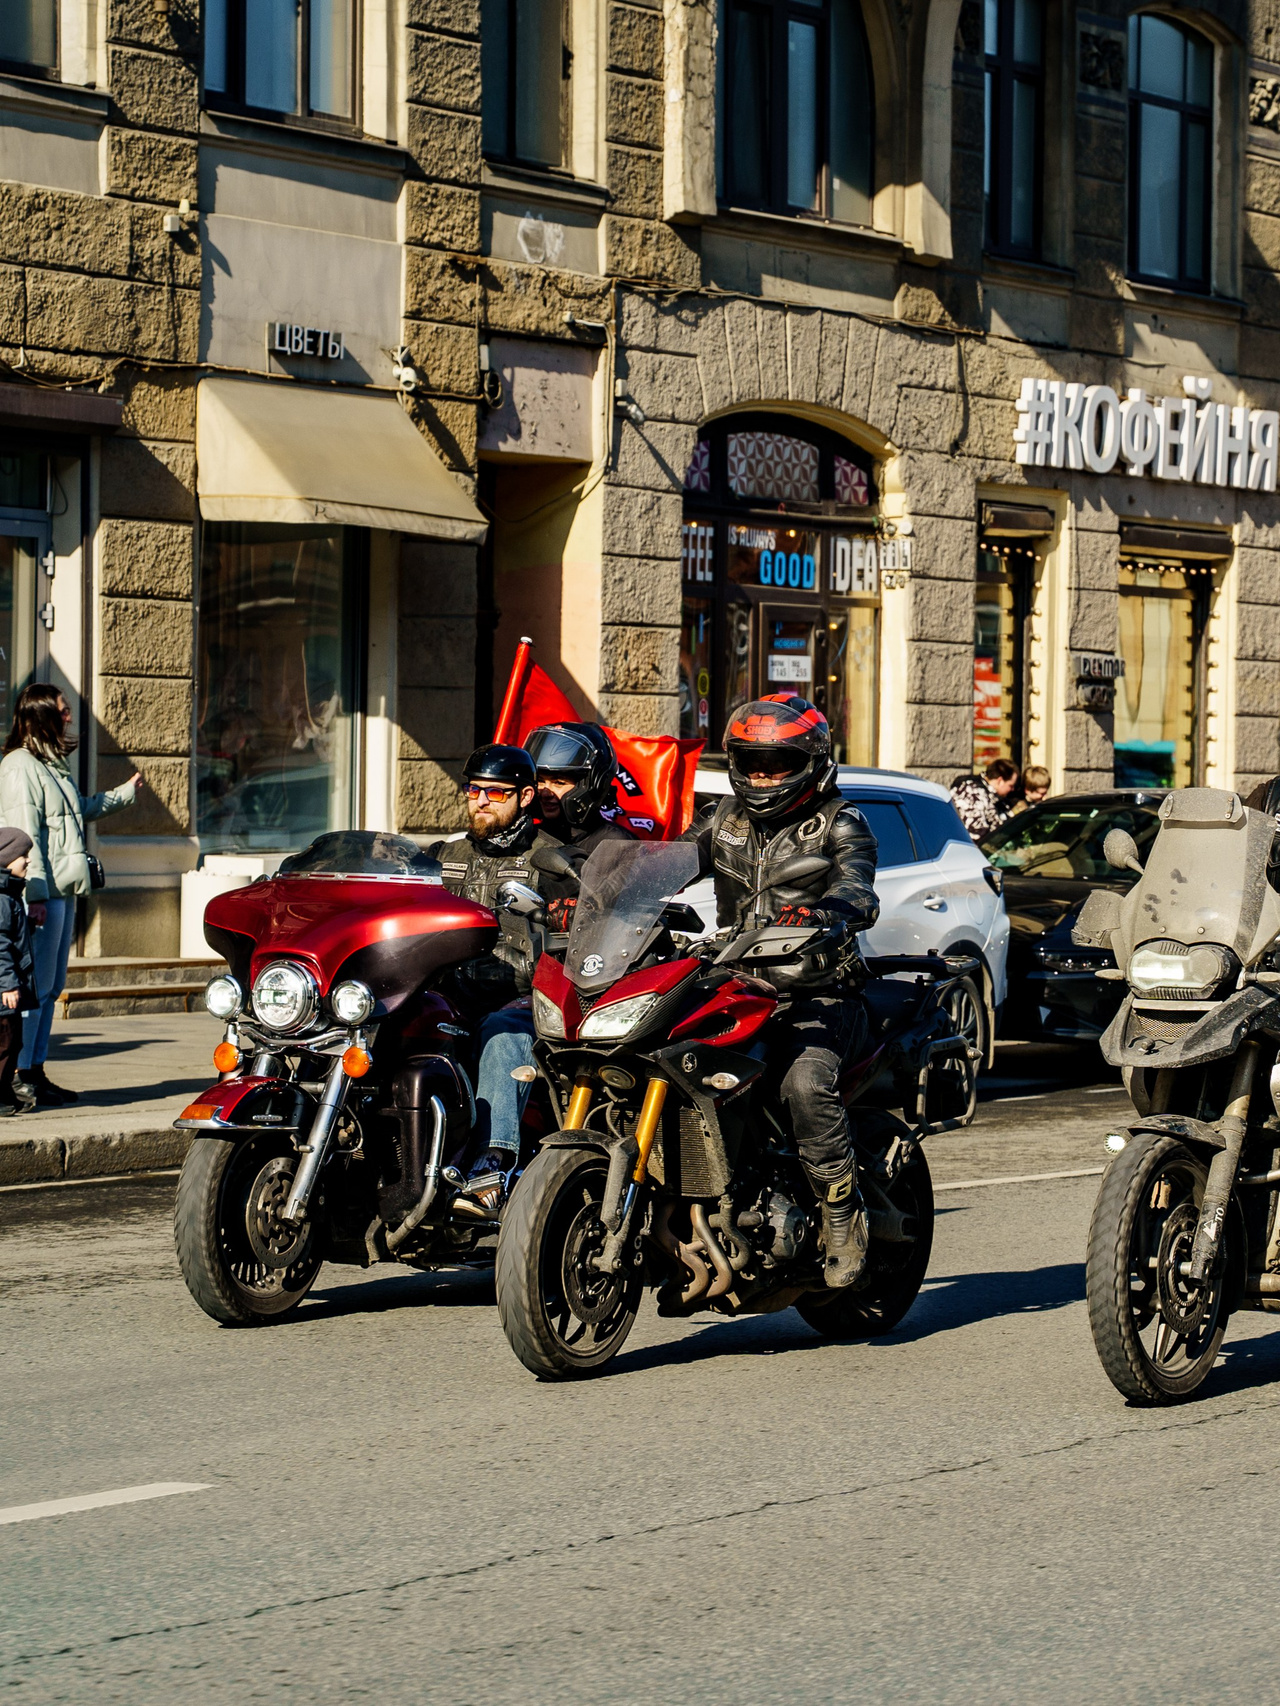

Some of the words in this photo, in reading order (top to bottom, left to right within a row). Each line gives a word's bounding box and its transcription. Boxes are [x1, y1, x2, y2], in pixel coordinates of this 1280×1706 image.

[275, 322, 344, 359] ЦВЕТЫ
[1013, 375, 1280, 493] #КОФЕЙНЯ
[728, 521, 738, 546] IS
[739, 526, 777, 551] ALWAYS
[759, 549, 816, 589] GOOD
[829, 535, 878, 592] IDEA
